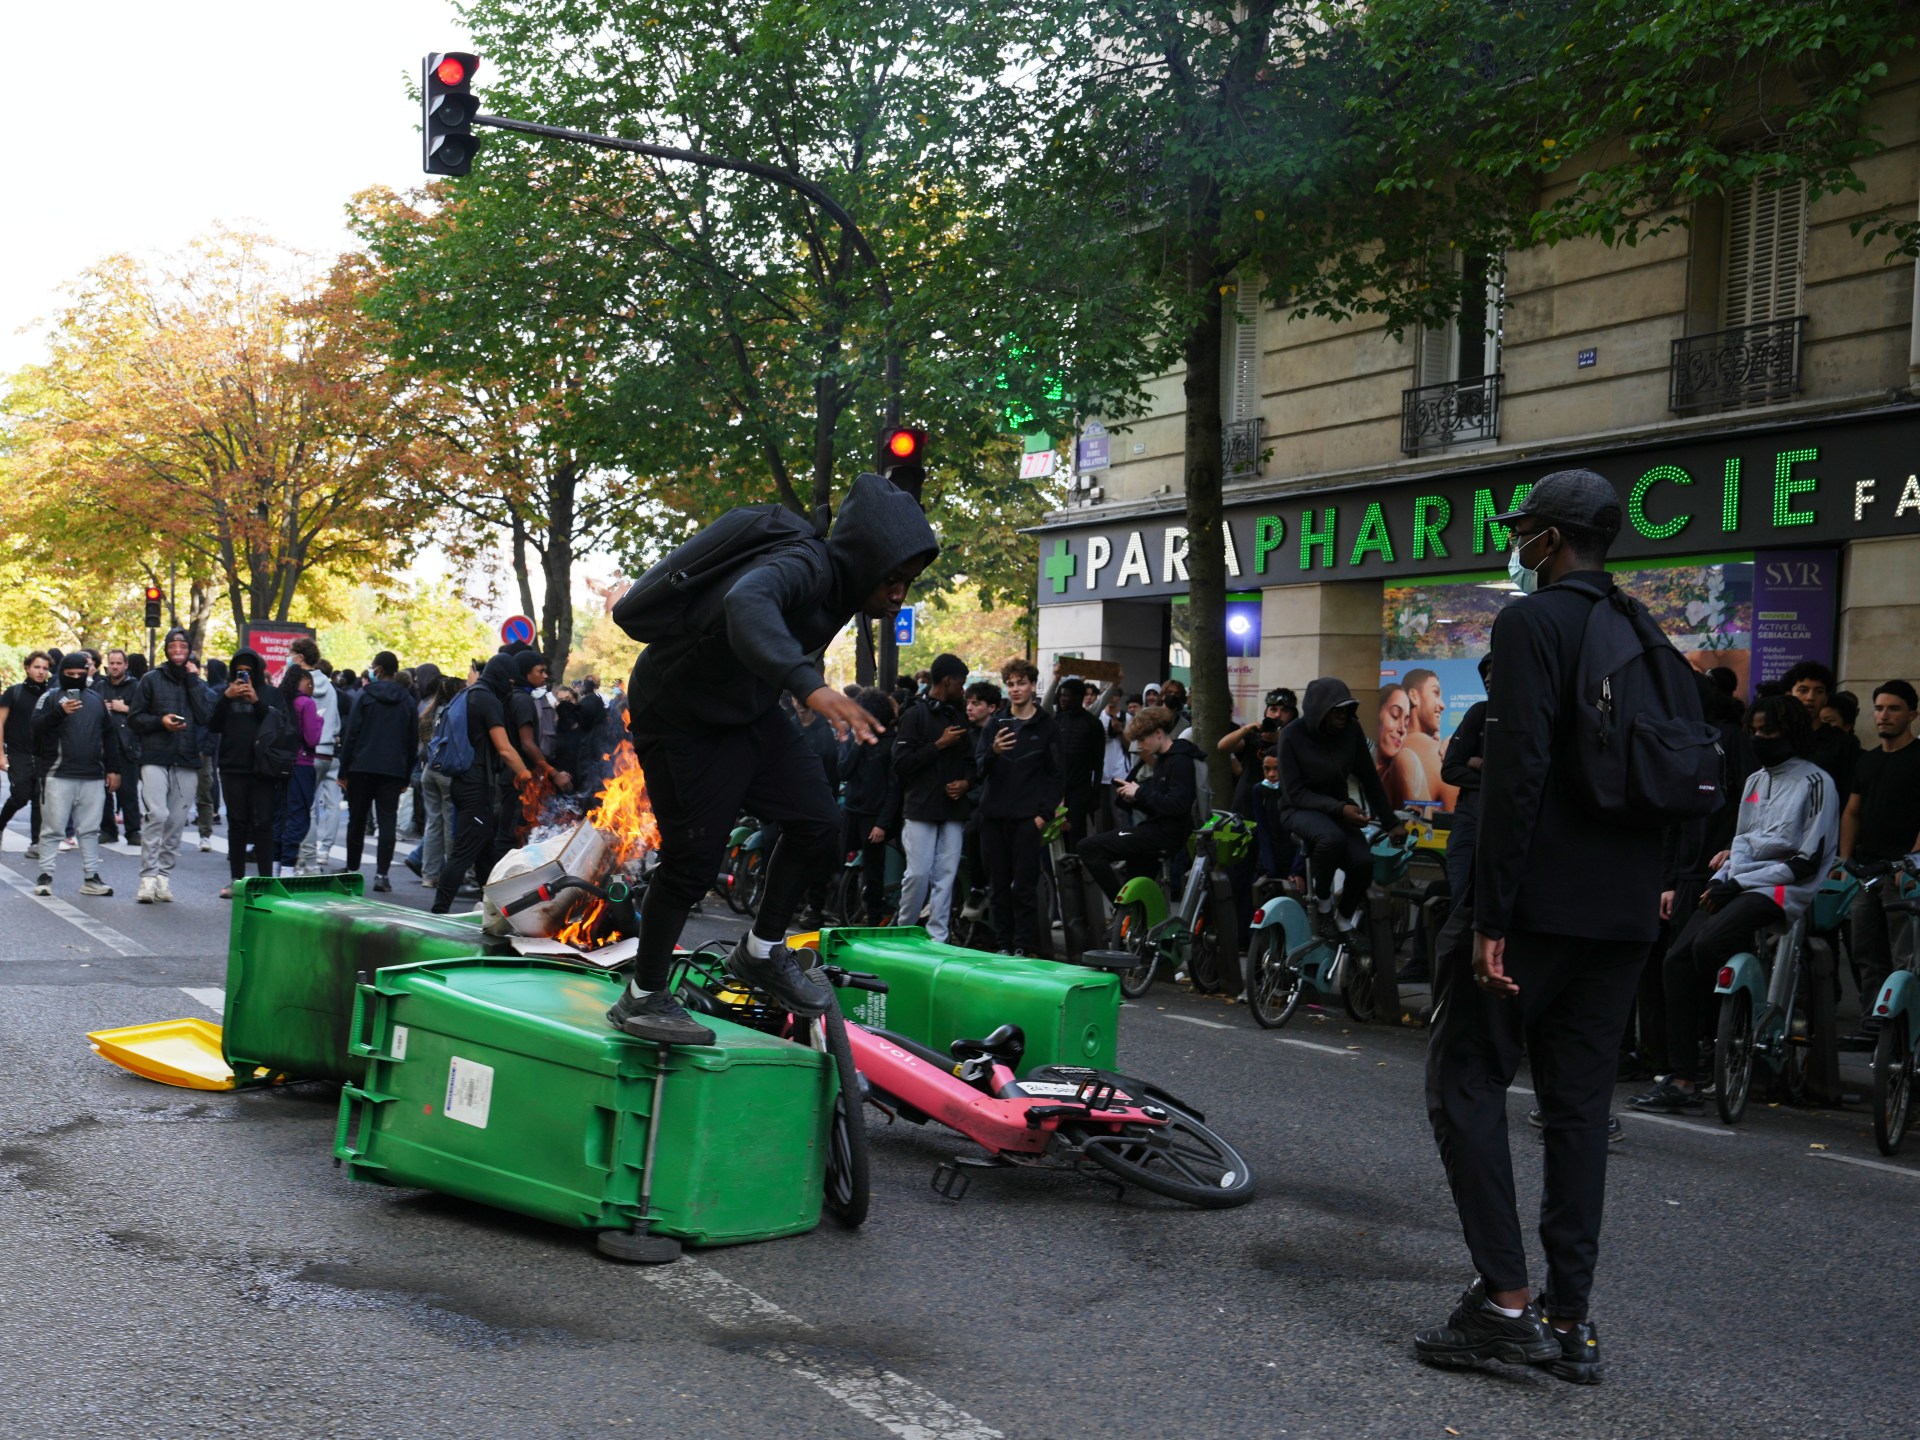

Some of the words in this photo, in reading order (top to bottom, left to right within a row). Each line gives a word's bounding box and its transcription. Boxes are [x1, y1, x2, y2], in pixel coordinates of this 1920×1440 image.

[1580, 351, 1594, 366] 22
[1025, 453, 1050, 477] 7/7
[1765, 562, 1823, 585] SVR
[1758, 623, 1789, 631] ACTIVE
[1791, 623, 1808, 631] GEL
[1757, 631, 1811, 639] SEBIACLEAR
[1228, 665, 1254, 673] forelle
